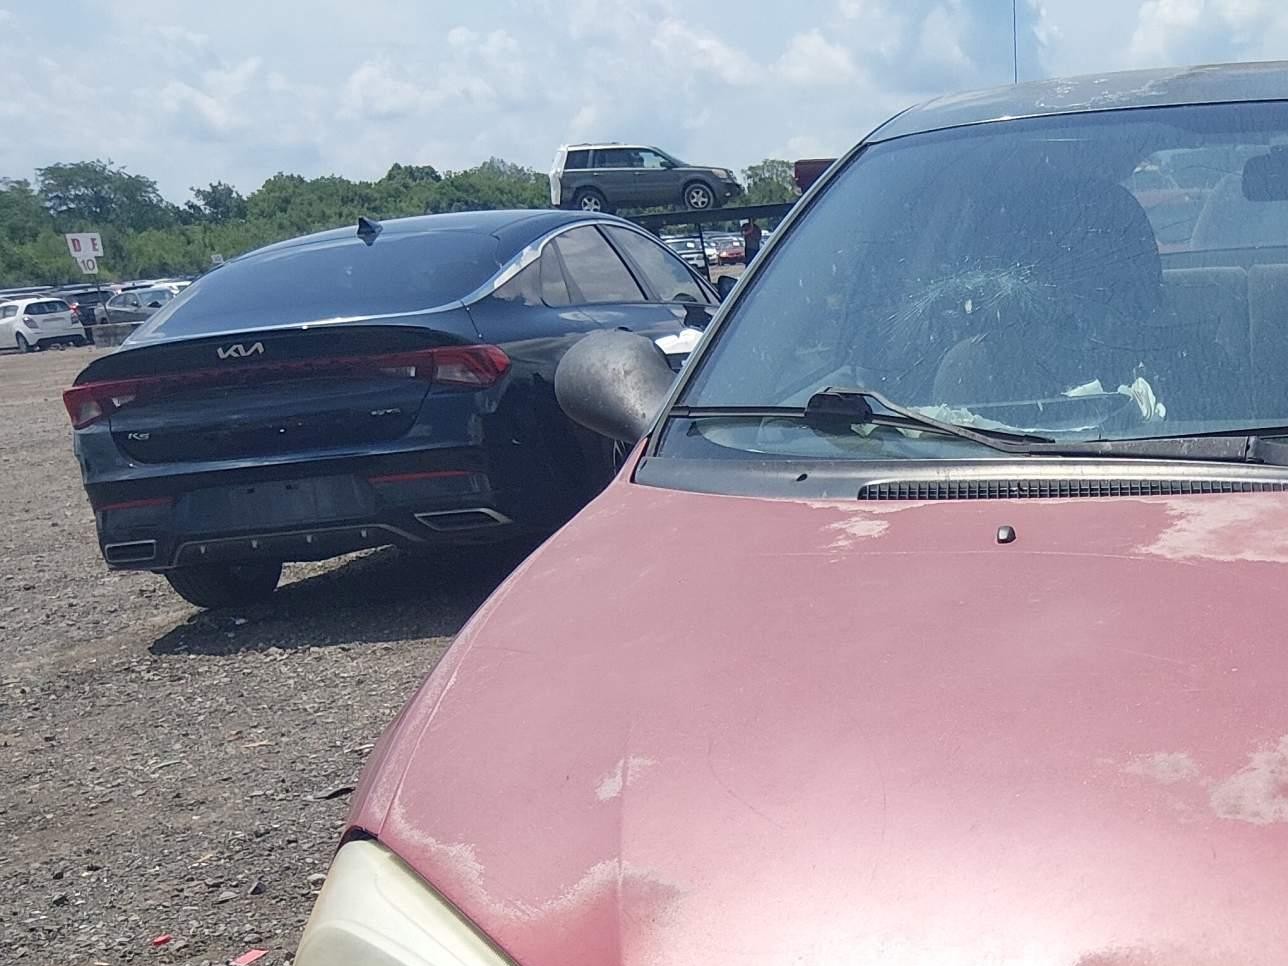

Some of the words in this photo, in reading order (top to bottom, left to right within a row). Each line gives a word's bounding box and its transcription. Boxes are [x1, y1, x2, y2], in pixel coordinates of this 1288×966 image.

[71, 238, 82, 252] D
[90, 238, 99, 251] E
[80, 259, 96, 271] 10
[216, 342, 265, 359] KIA
